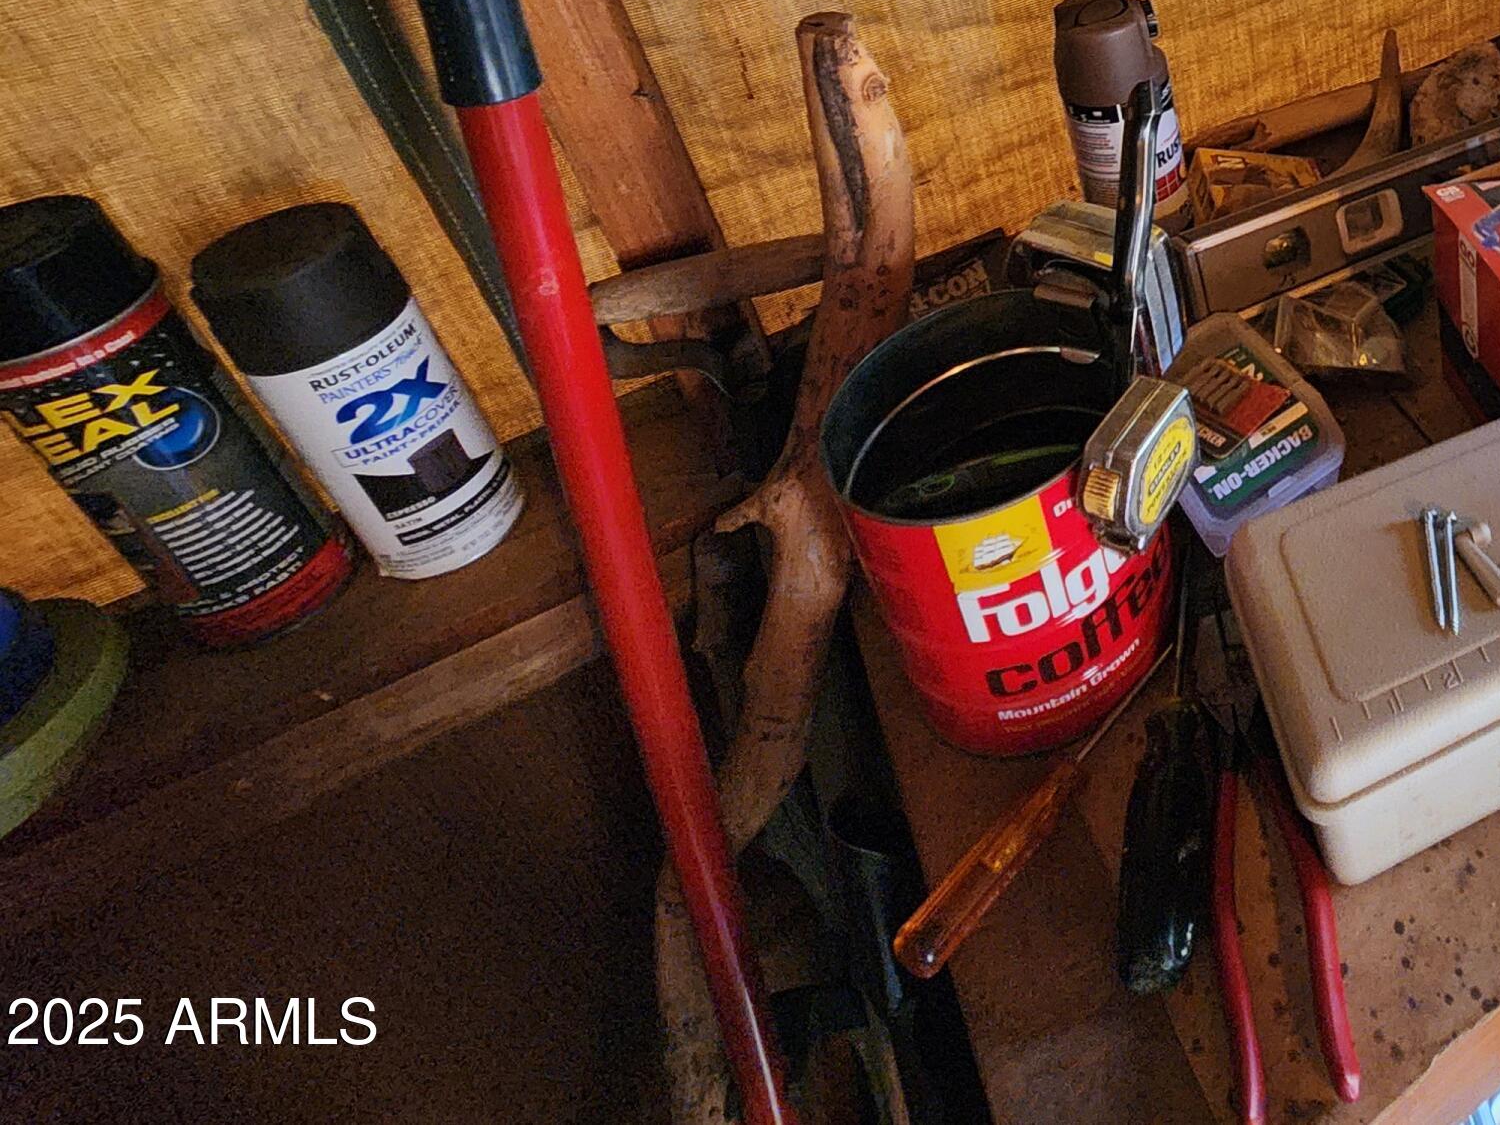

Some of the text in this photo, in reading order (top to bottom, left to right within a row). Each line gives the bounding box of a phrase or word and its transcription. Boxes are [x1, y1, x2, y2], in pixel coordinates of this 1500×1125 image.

[1155, 140, 1181, 169] RUS
[309, 323, 418, 392] RUST-OLEUM
[0, 369, 168, 437] LEX
[33, 402, 180, 465] EAL
[336, 355, 449, 445] 2X
[957, 547, 1128, 645] Folg
[997, 685, 1088, 722] Mountain
[1089, 638, 1141, 687] Grown
